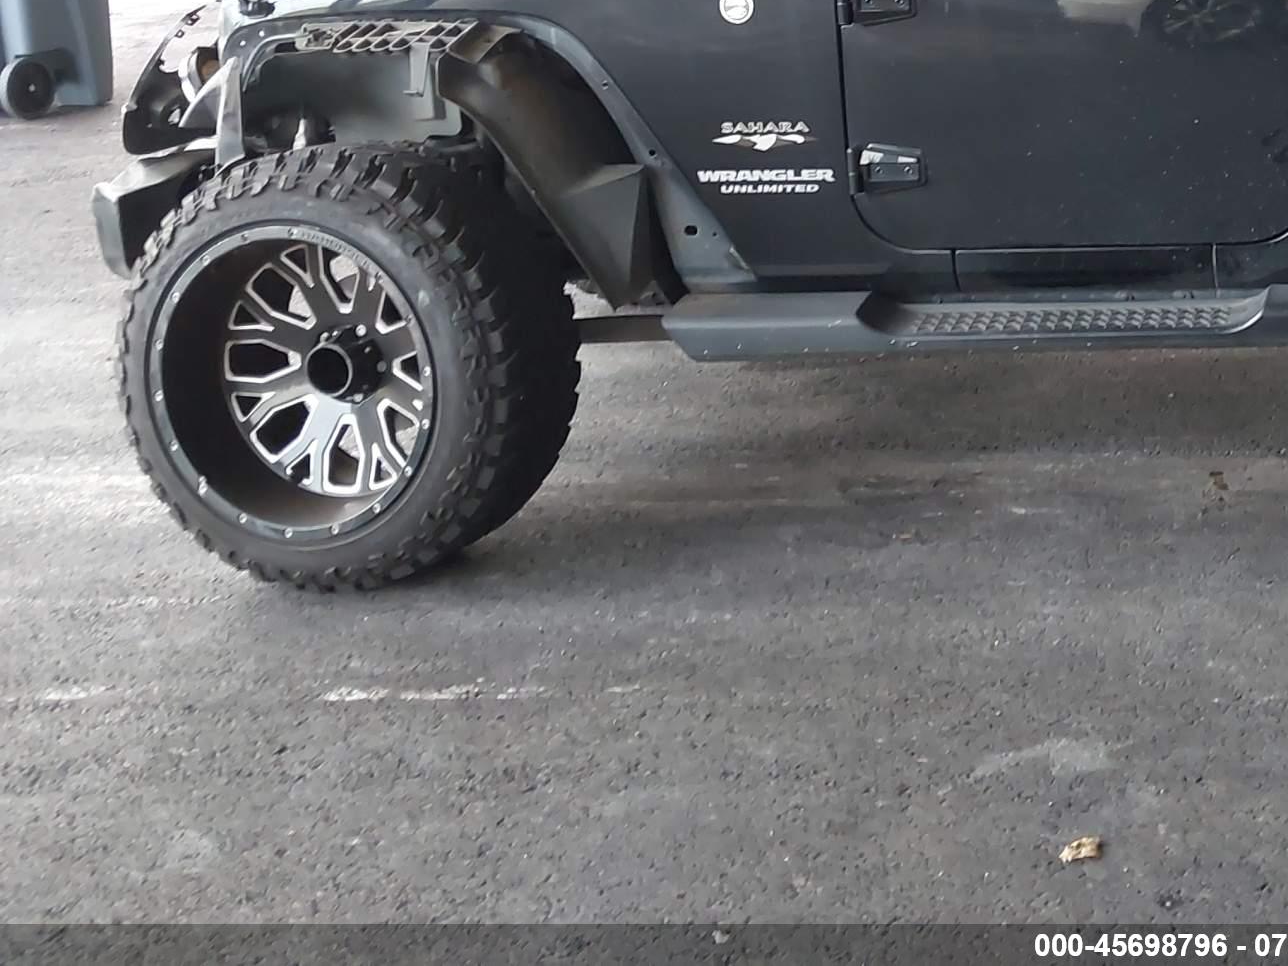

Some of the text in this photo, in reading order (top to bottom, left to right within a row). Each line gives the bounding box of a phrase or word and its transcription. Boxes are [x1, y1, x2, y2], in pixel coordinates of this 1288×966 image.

[720, 121, 810, 134] SAHARA
[697, 168, 835, 183] WRANGLER
[720, 183, 820, 195] UNLIMITED
